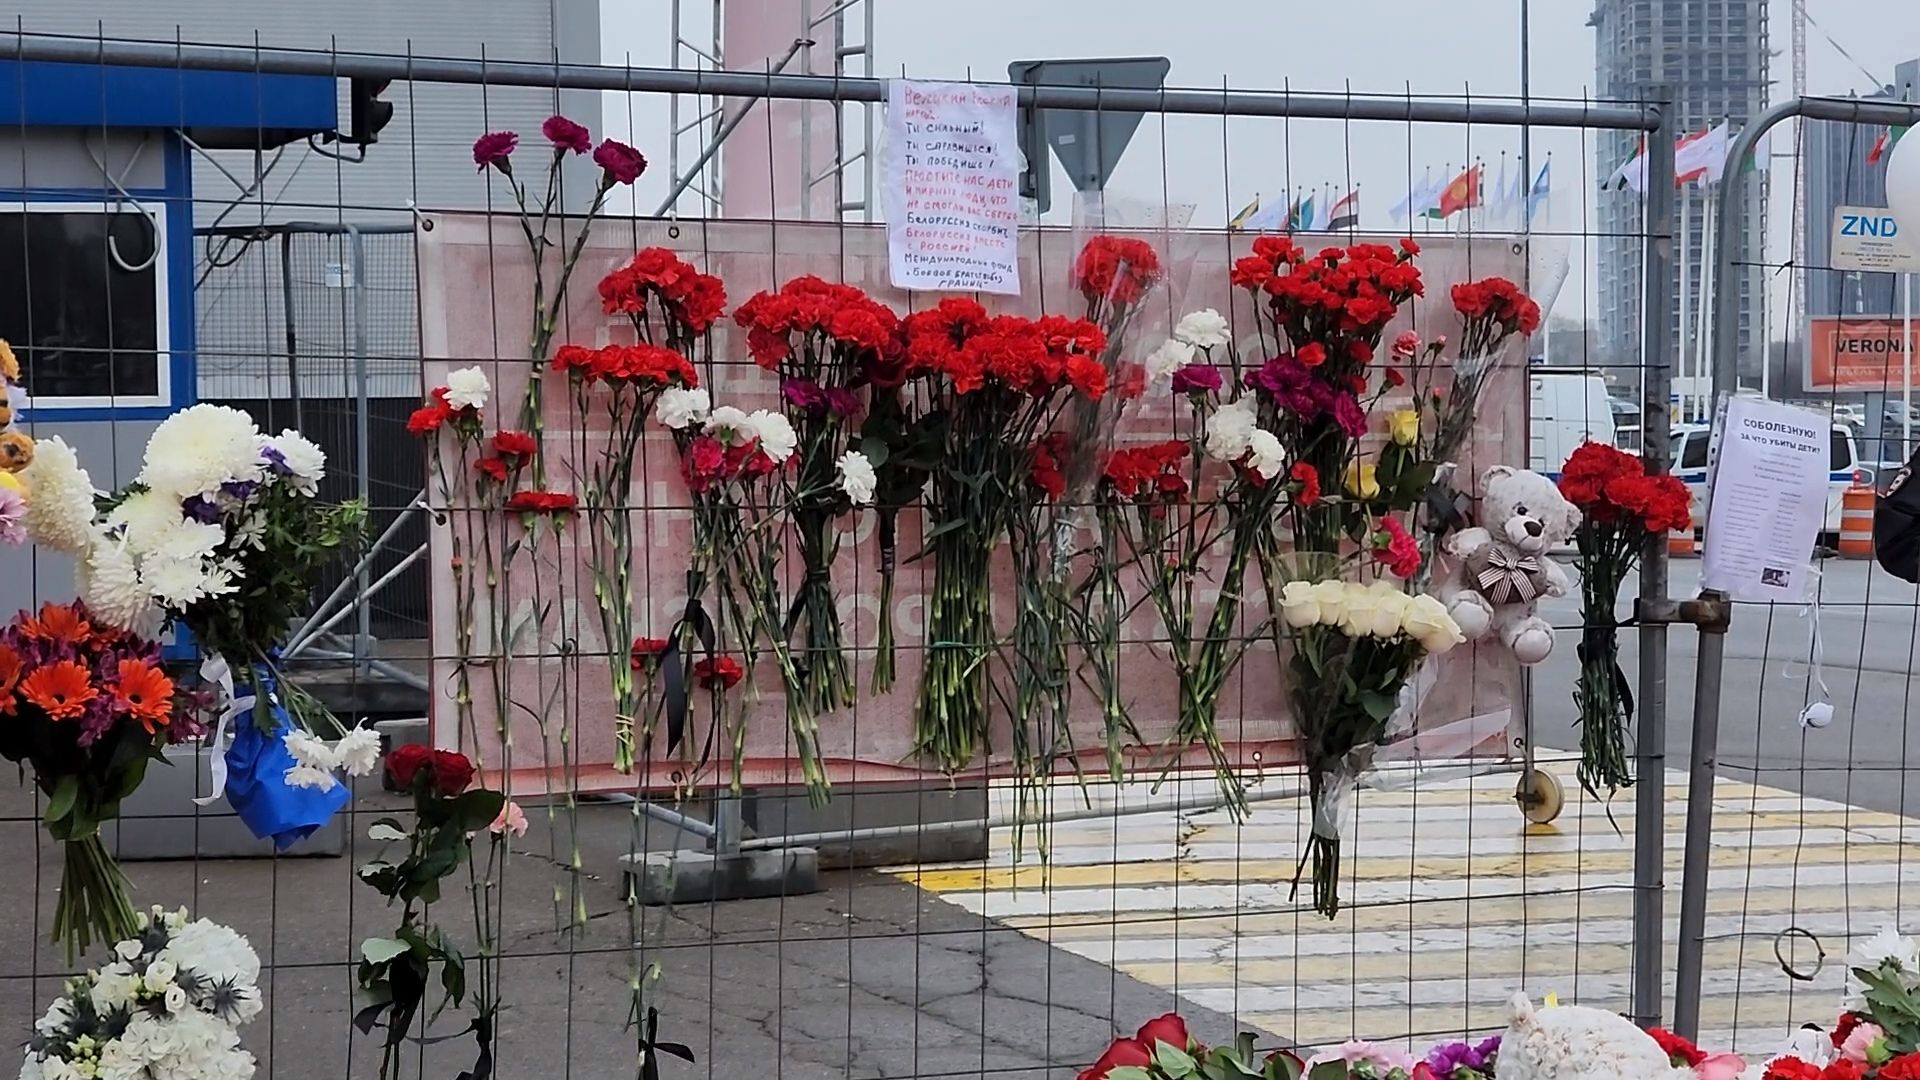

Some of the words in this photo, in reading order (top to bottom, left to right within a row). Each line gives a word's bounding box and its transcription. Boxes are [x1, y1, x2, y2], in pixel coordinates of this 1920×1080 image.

[905, 185, 912, 195] И
[964, 175, 985, 186] НАС
[986, 178, 1013, 191] ДЕТИ
[1841, 215, 1897, 238] ZND
[1743, 418, 1816, 439] СОБОЛЕЗНУЮ!
[1740, 432, 1750, 441] ЗА
[1752, 435, 1767, 445] ЧТО
[1769, 439, 1796, 449] УБИТЫ
[1797, 443, 1821, 454] ДЕТИ?
